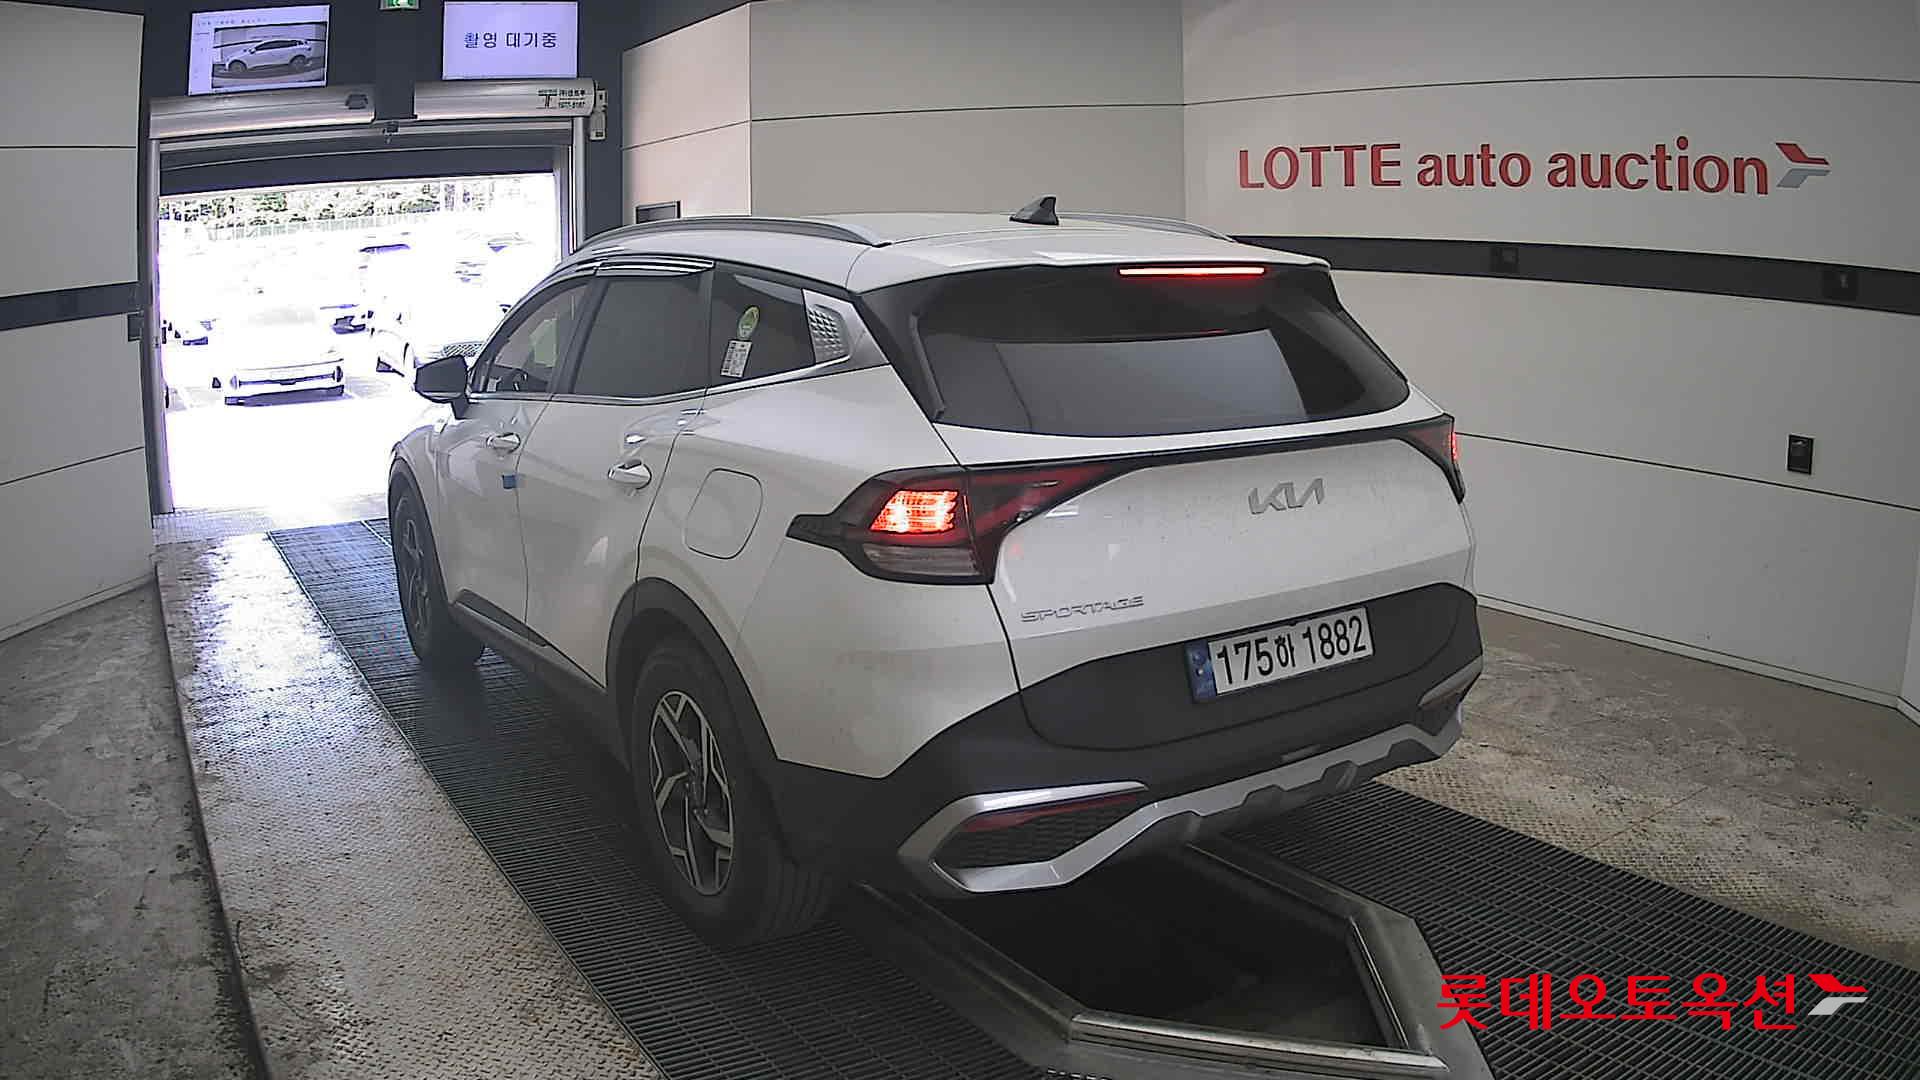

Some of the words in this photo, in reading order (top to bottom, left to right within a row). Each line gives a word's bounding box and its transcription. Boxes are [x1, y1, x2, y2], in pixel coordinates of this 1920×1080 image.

[464, 32, 498, 49] 촬영
[505, 32, 558, 49] 대기중
[1238, 143, 1402, 189] LOTTE
[1416, 143, 1532, 188] auto
[1547, 136, 1769, 195] auction
[1248, 477, 1325, 515] KIA
[1020, 596, 1144, 622] SPORTAGE
[1217, 633, 1296, 685] 175하
[1302, 615, 1367, 664] 1882
